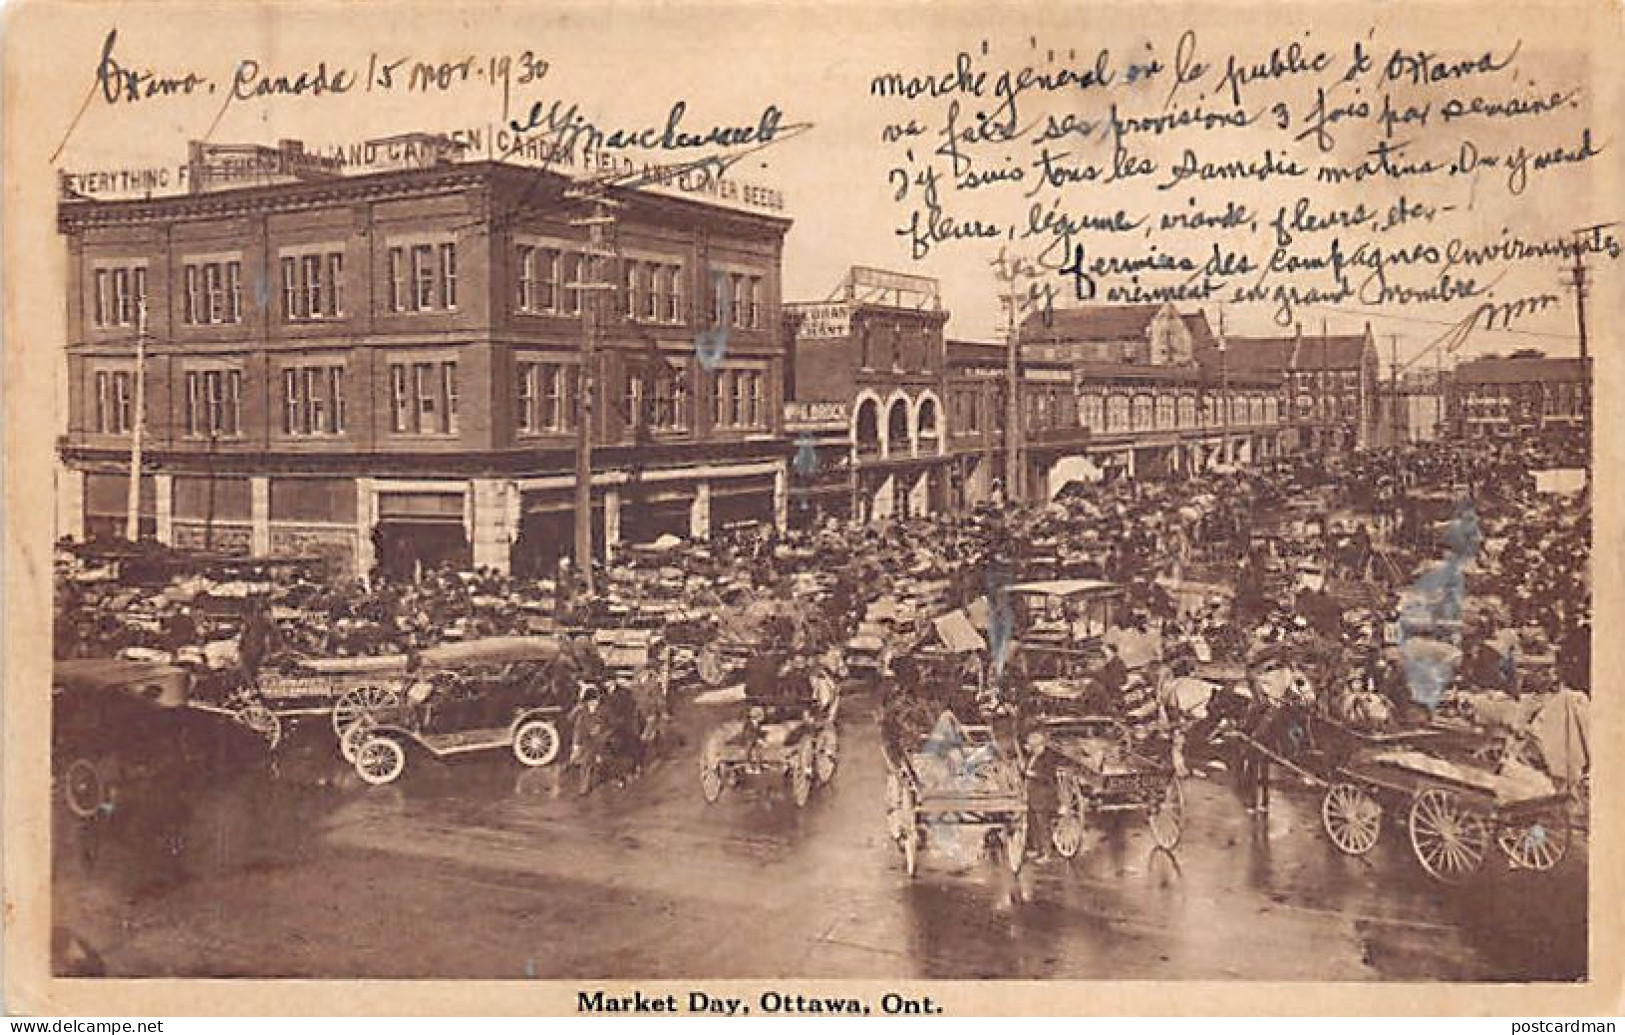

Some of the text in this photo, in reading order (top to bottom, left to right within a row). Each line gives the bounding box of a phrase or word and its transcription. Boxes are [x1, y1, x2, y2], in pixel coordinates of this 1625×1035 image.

[366, 52, 410, 92] 15
[489, 51, 549, 121] 1930
[1272, 101, 1290, 129] 3
[1295, 87, 1370, 151] fois
[1377, 93, 1432, 138] par
[63, 167, 169, 197] EVERYTHING
[583, 146, 634, 176] FIELD
[743, 184, 783, 210] SEEDS
[1025, 148, 1103, 198] tous
[1103, 148, 1158, 184] les
[1274, 277, 1355, 326] grand
